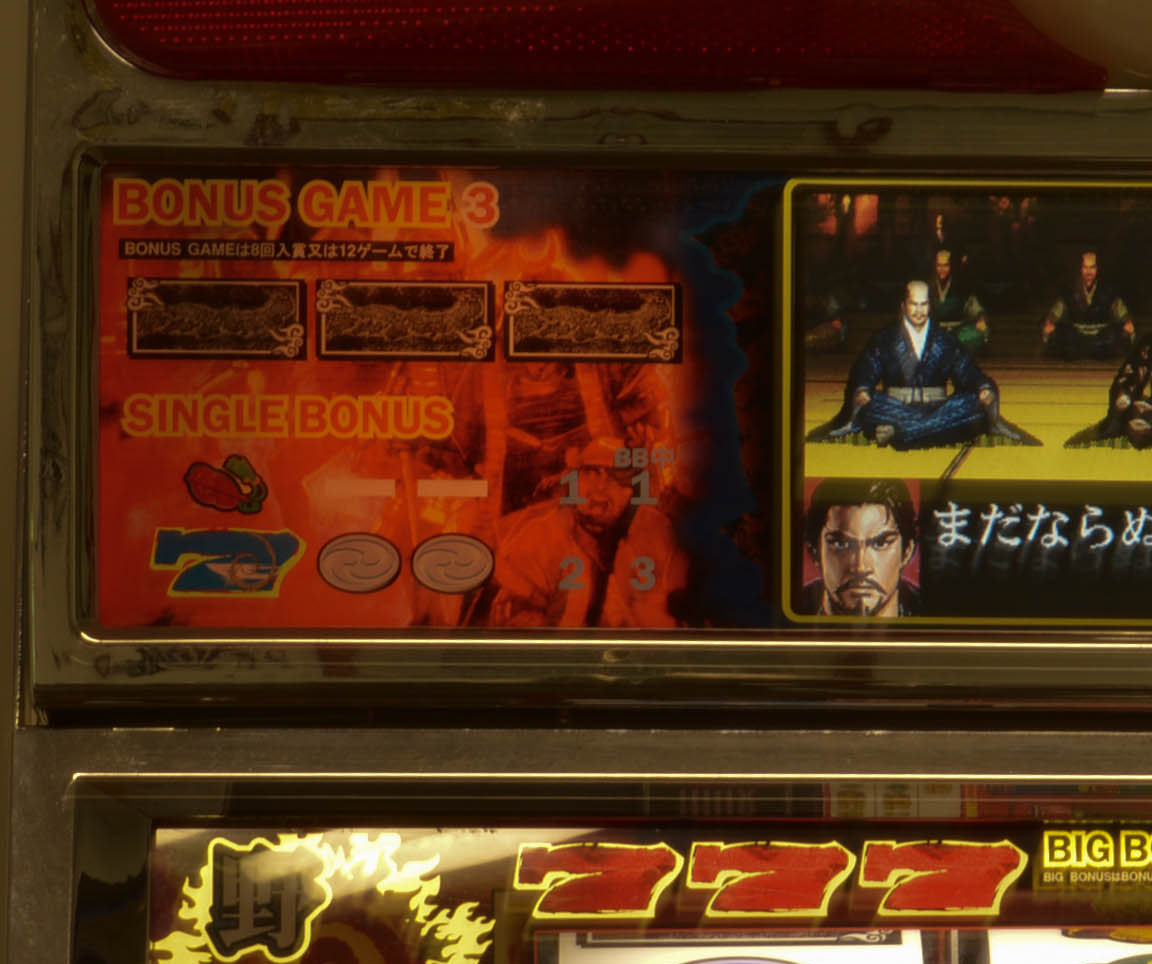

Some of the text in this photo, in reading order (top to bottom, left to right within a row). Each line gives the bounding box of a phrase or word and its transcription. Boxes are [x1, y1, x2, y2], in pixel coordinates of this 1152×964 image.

[113, 178, 500, 229] BONUS GAME 3
[124, 242, 181, 257] BONUS
[121, 392, 455, 440] SINGLE BONUS
[560, 470, 658, 504] 1 1
[559, 556, 656, 591] 2 3
[1043, 830, 1115, 868] BIG
[1043, 872, 1064, 882] BIG
